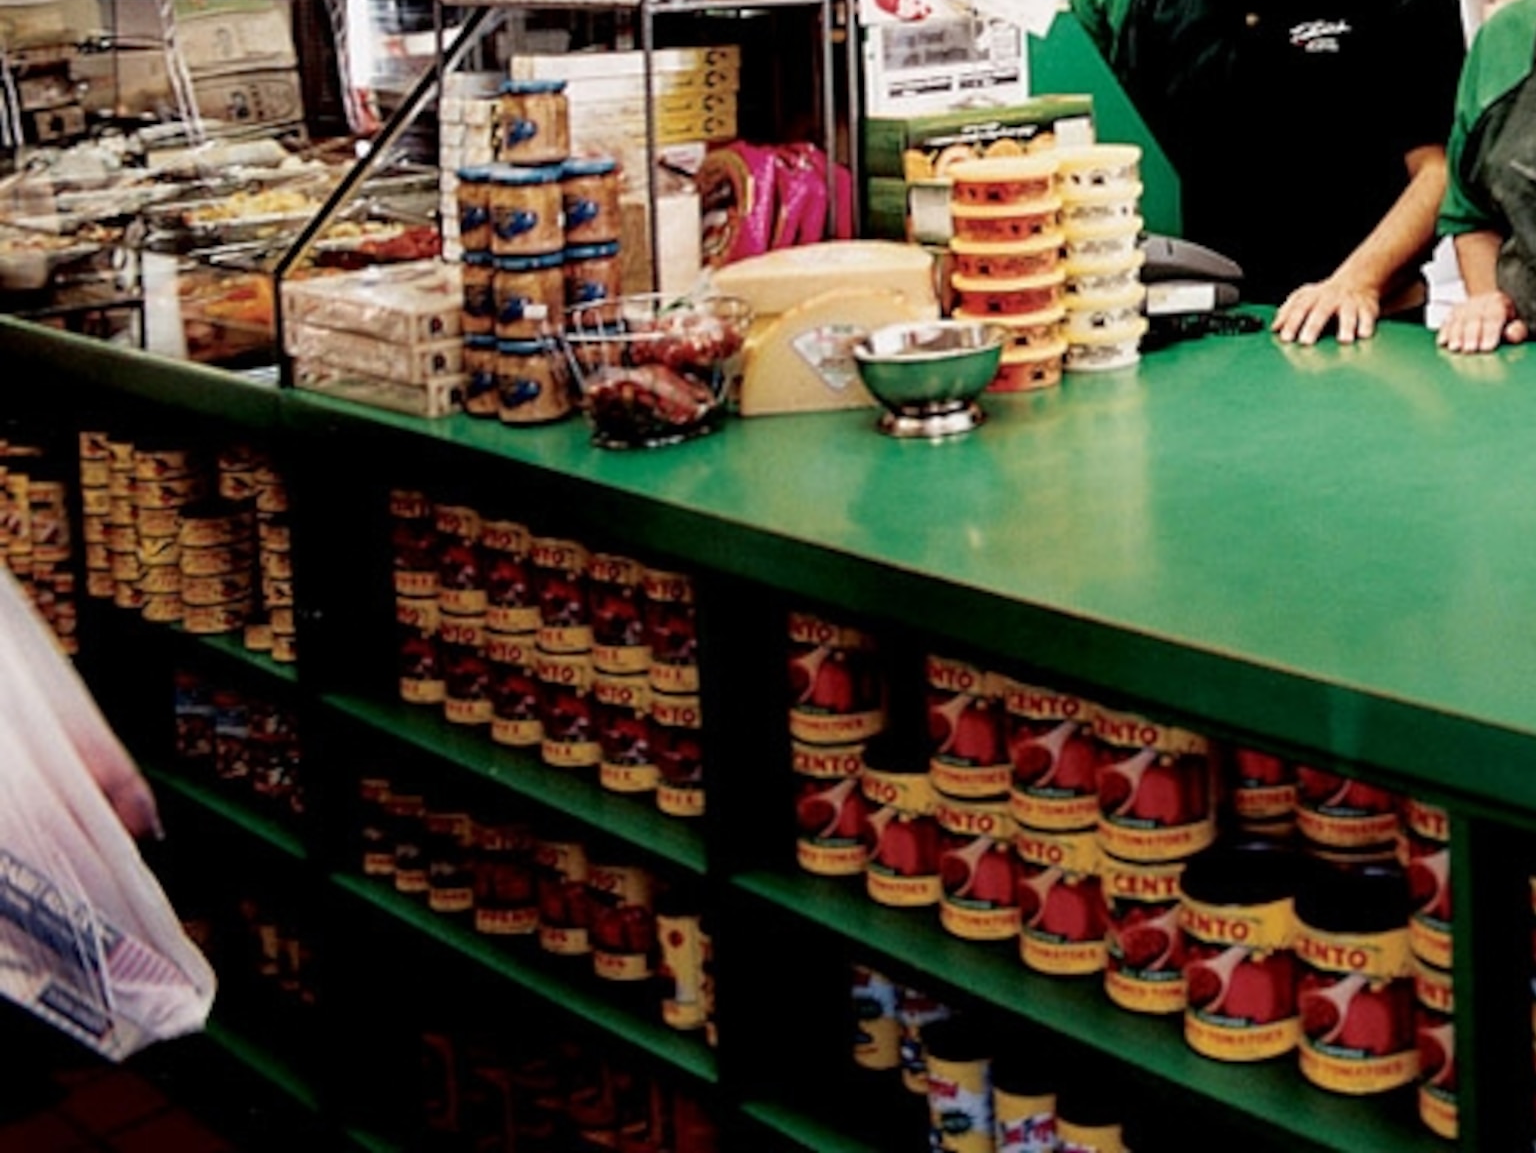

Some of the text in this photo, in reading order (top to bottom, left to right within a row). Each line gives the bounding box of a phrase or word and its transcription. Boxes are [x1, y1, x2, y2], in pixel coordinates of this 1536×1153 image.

[788, 615, 834, 643] NTO
[928, 661, 973, 687] NTO
[1018, 834, 1063, 864] NTO
[1114, 873, 1178, 893] CENT
